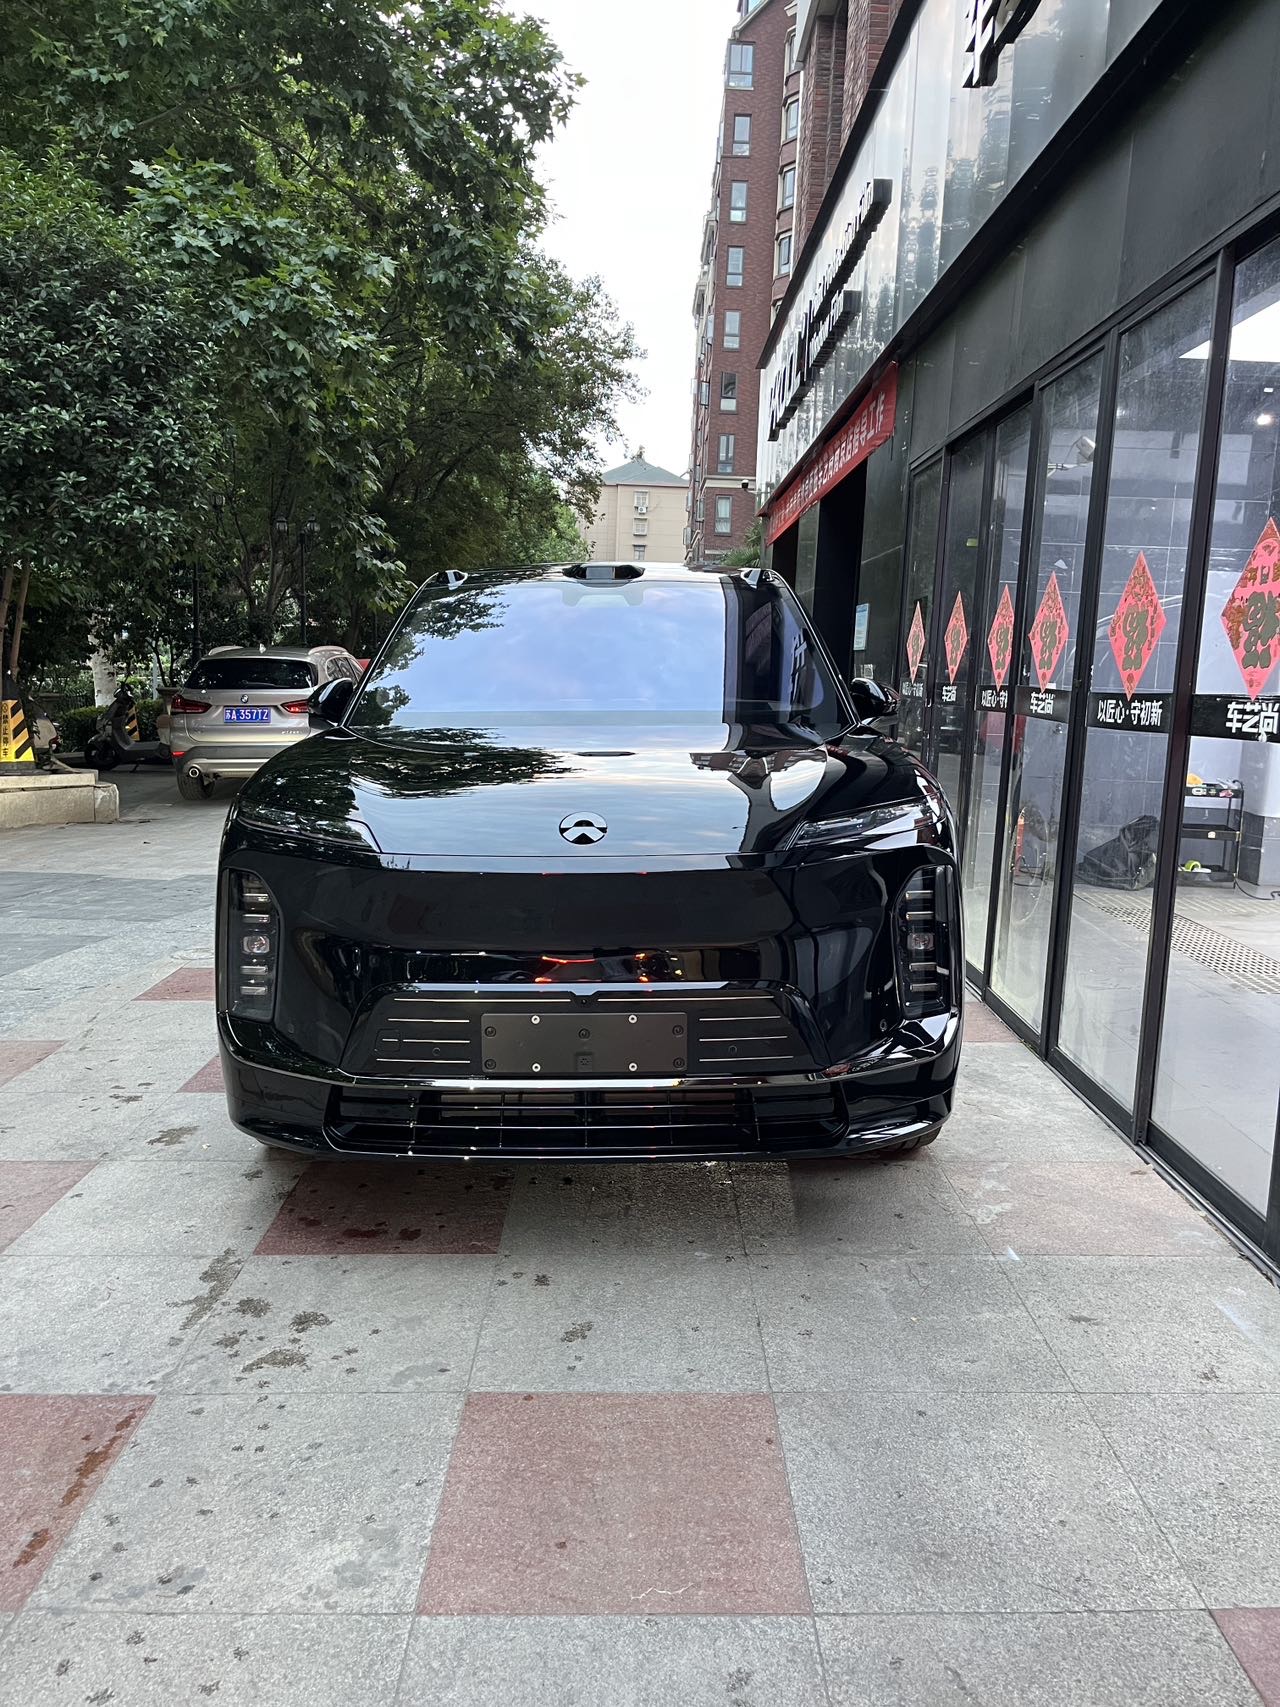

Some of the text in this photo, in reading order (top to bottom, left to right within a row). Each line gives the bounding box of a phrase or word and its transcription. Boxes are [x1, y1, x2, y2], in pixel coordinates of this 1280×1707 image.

[942, 685, 957, 702] 车艺尚
[1030, 691, 1055, 715] 车艺尚
[1097, 699, 1162, 727] 以匠心·守初新
[1226, 701, 1280, 734] 车艺尚
